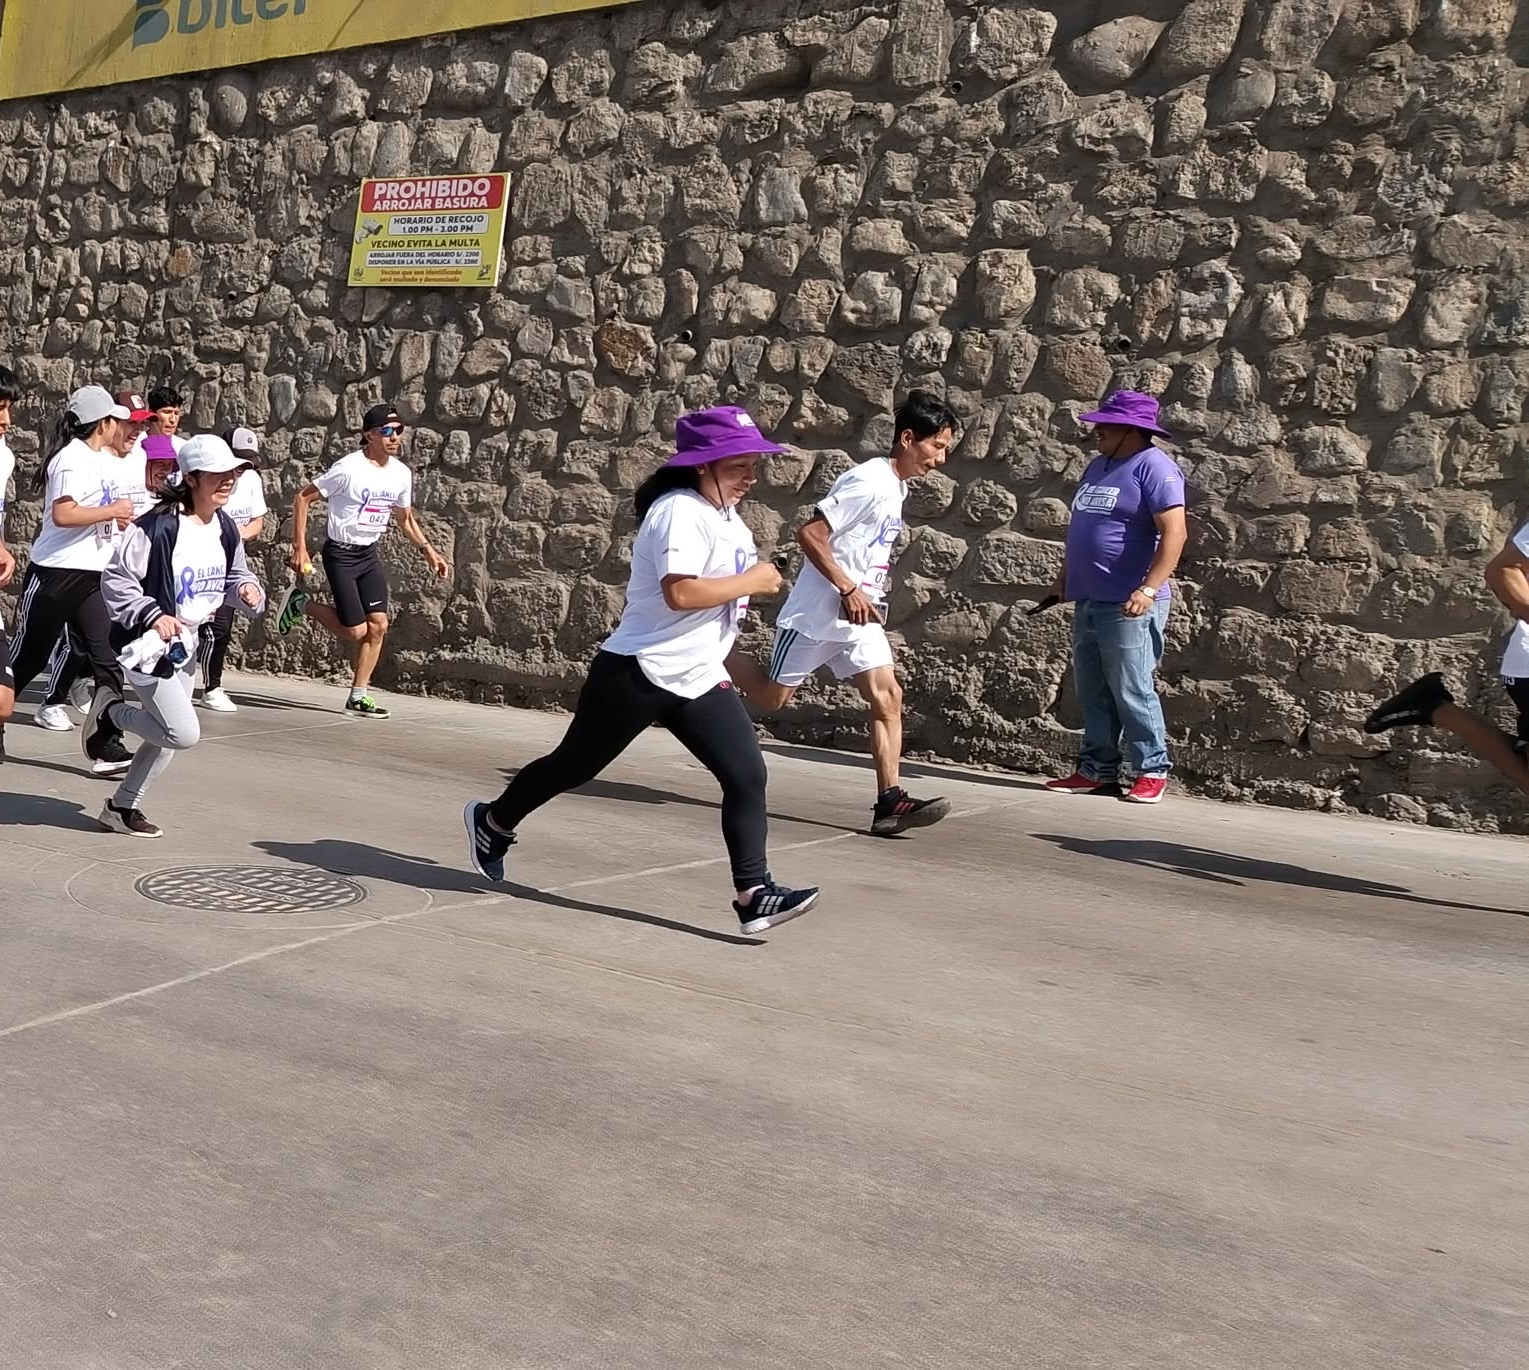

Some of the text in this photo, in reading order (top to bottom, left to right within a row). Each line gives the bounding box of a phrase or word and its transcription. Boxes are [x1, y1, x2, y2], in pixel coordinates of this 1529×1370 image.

[374, 178, 491, 199] PROHIBIDO
[373, 196, 488, 211] ARROJAR BASURA
[393, 215, 484, 225] HORARIO DE RECOJO
[402, 226, 419, 234] 1.00
[420, 225, 433, 233] PM
[371, 238, 480, 248] VECINO EVITA LA MULTA
